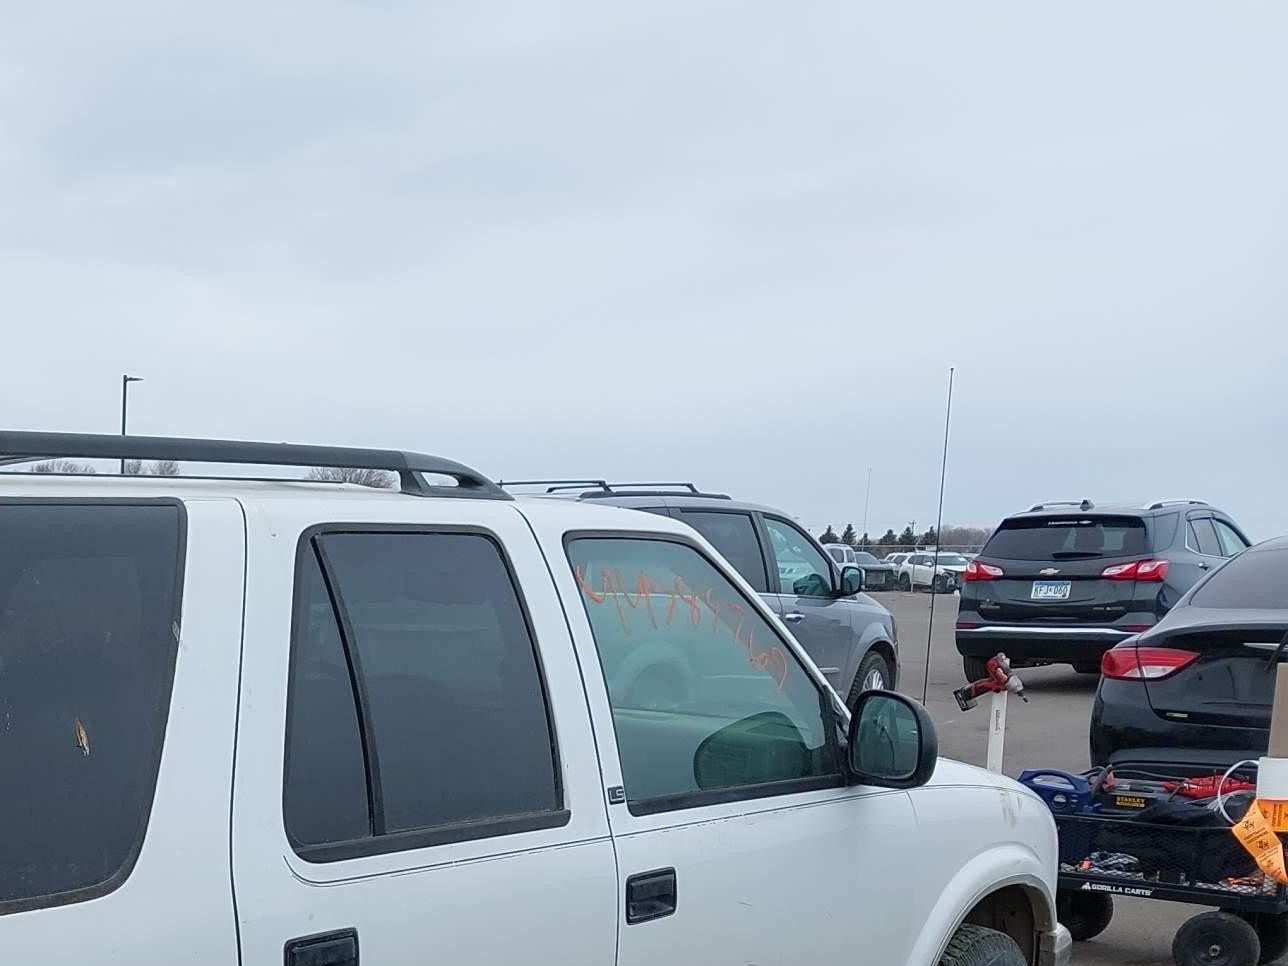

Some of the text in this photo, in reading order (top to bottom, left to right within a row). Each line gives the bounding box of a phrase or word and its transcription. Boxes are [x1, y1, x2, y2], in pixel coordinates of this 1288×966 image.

[608, 787, 625, 803] LS
[1091, 883, 1151, 896] GORILLA CARTS
